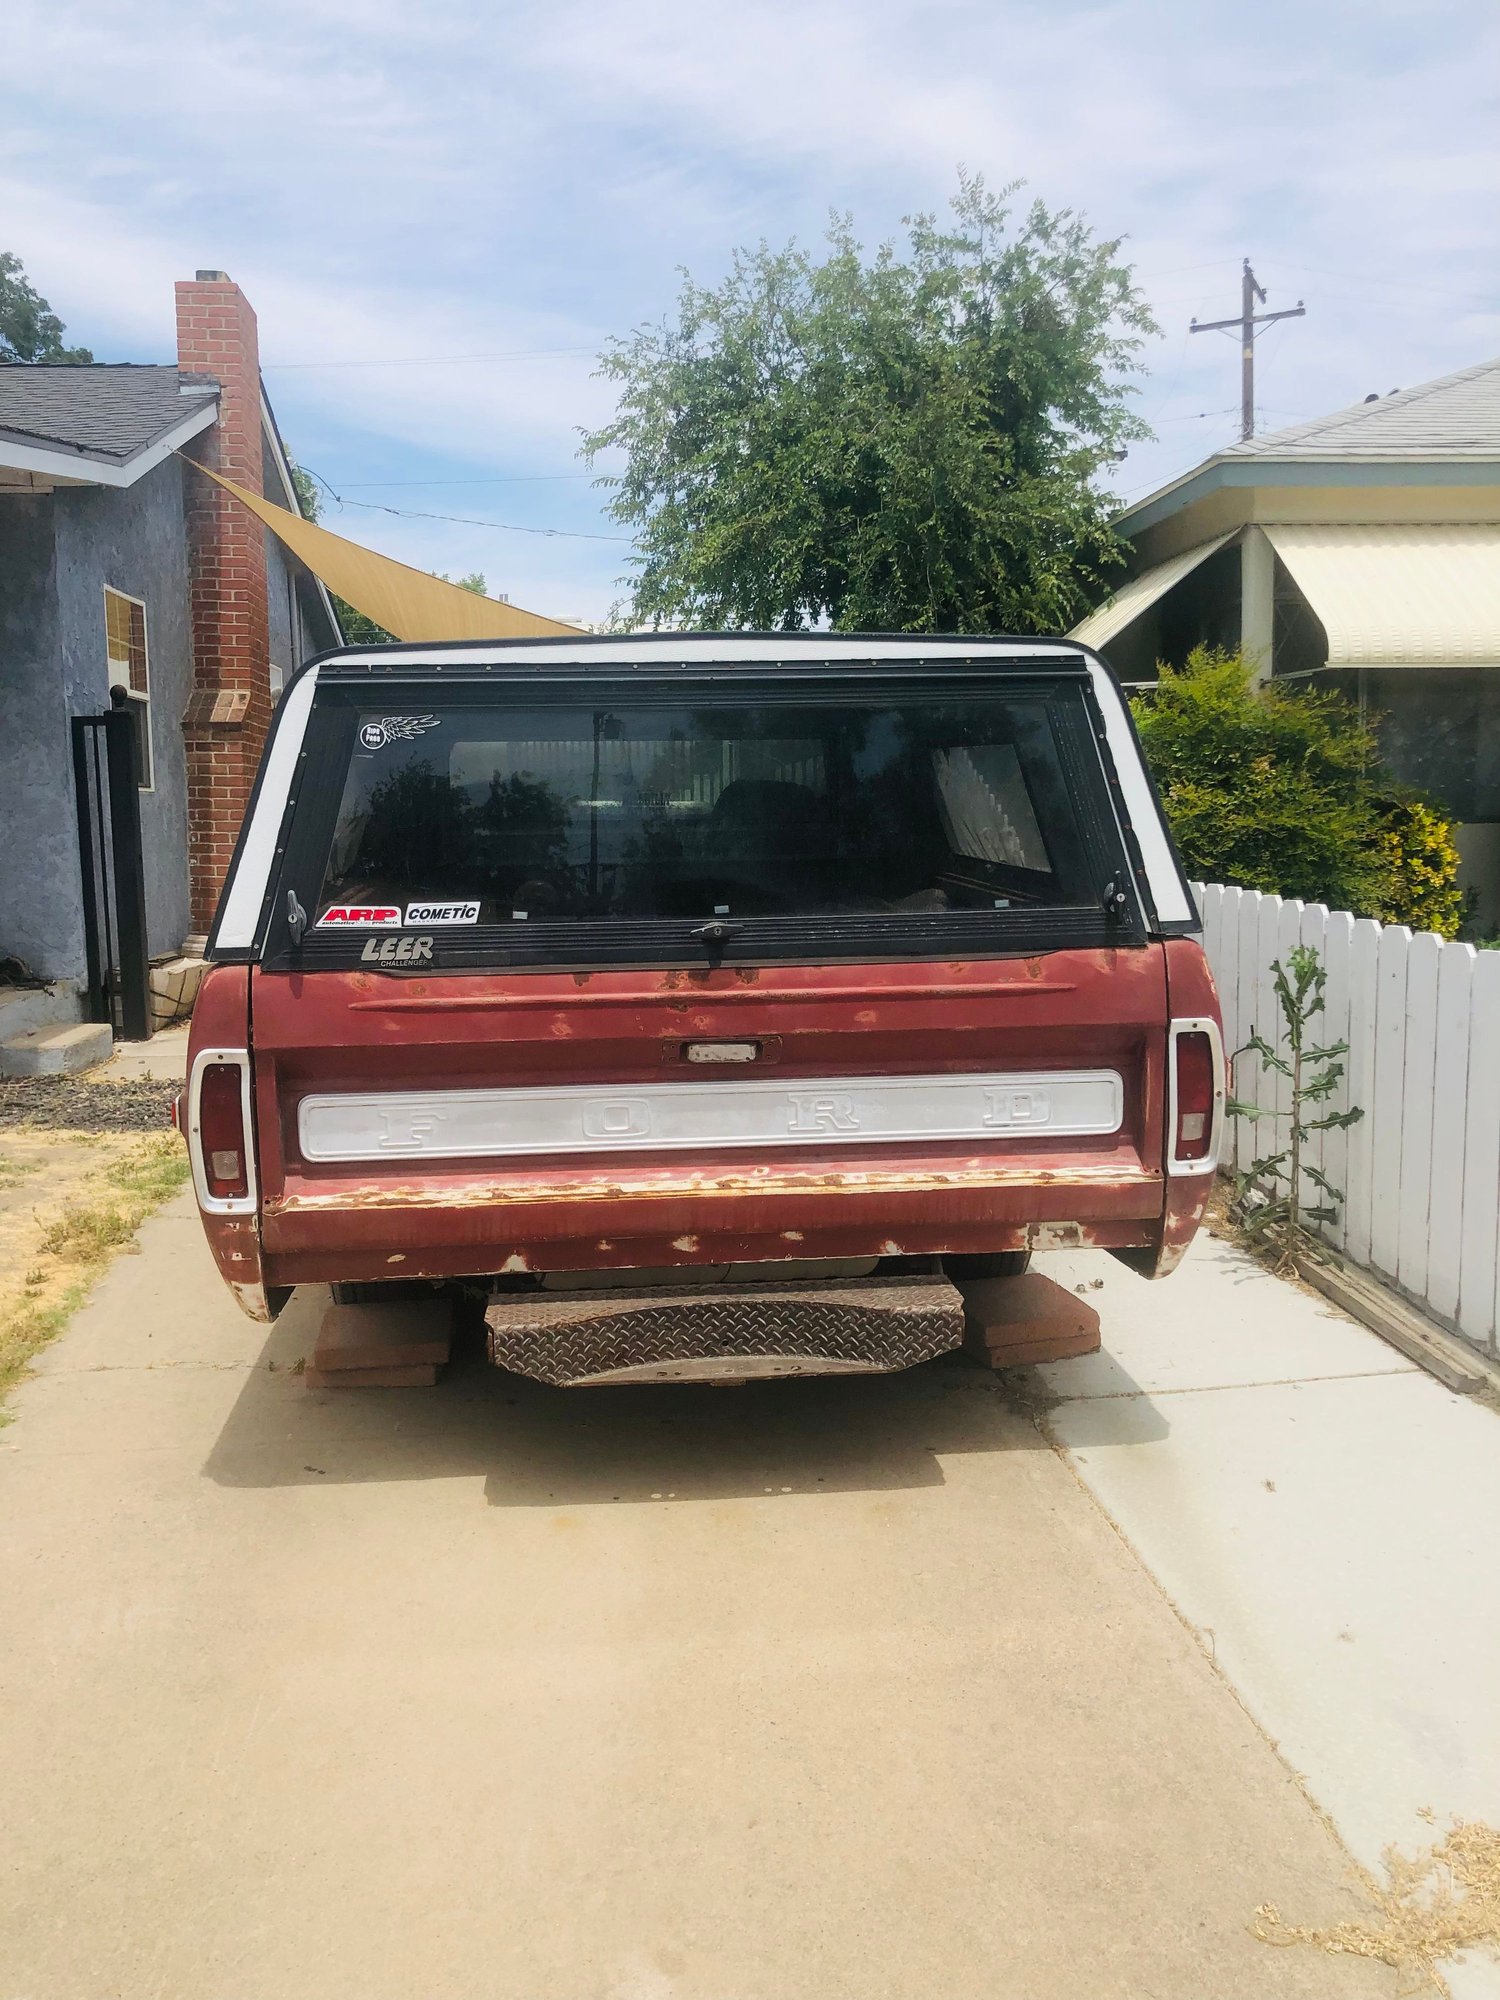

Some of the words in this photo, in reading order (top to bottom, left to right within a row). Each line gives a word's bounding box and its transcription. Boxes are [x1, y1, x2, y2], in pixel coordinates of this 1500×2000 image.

[323, 909, 398, 921] ARP
[408, 905, 477, 920] COMETIC
[361, 936, 434, 961] LEER
[380, 959, 428, 968] CHALLENGER
[378, 1087, 1053, 1148] FORD
